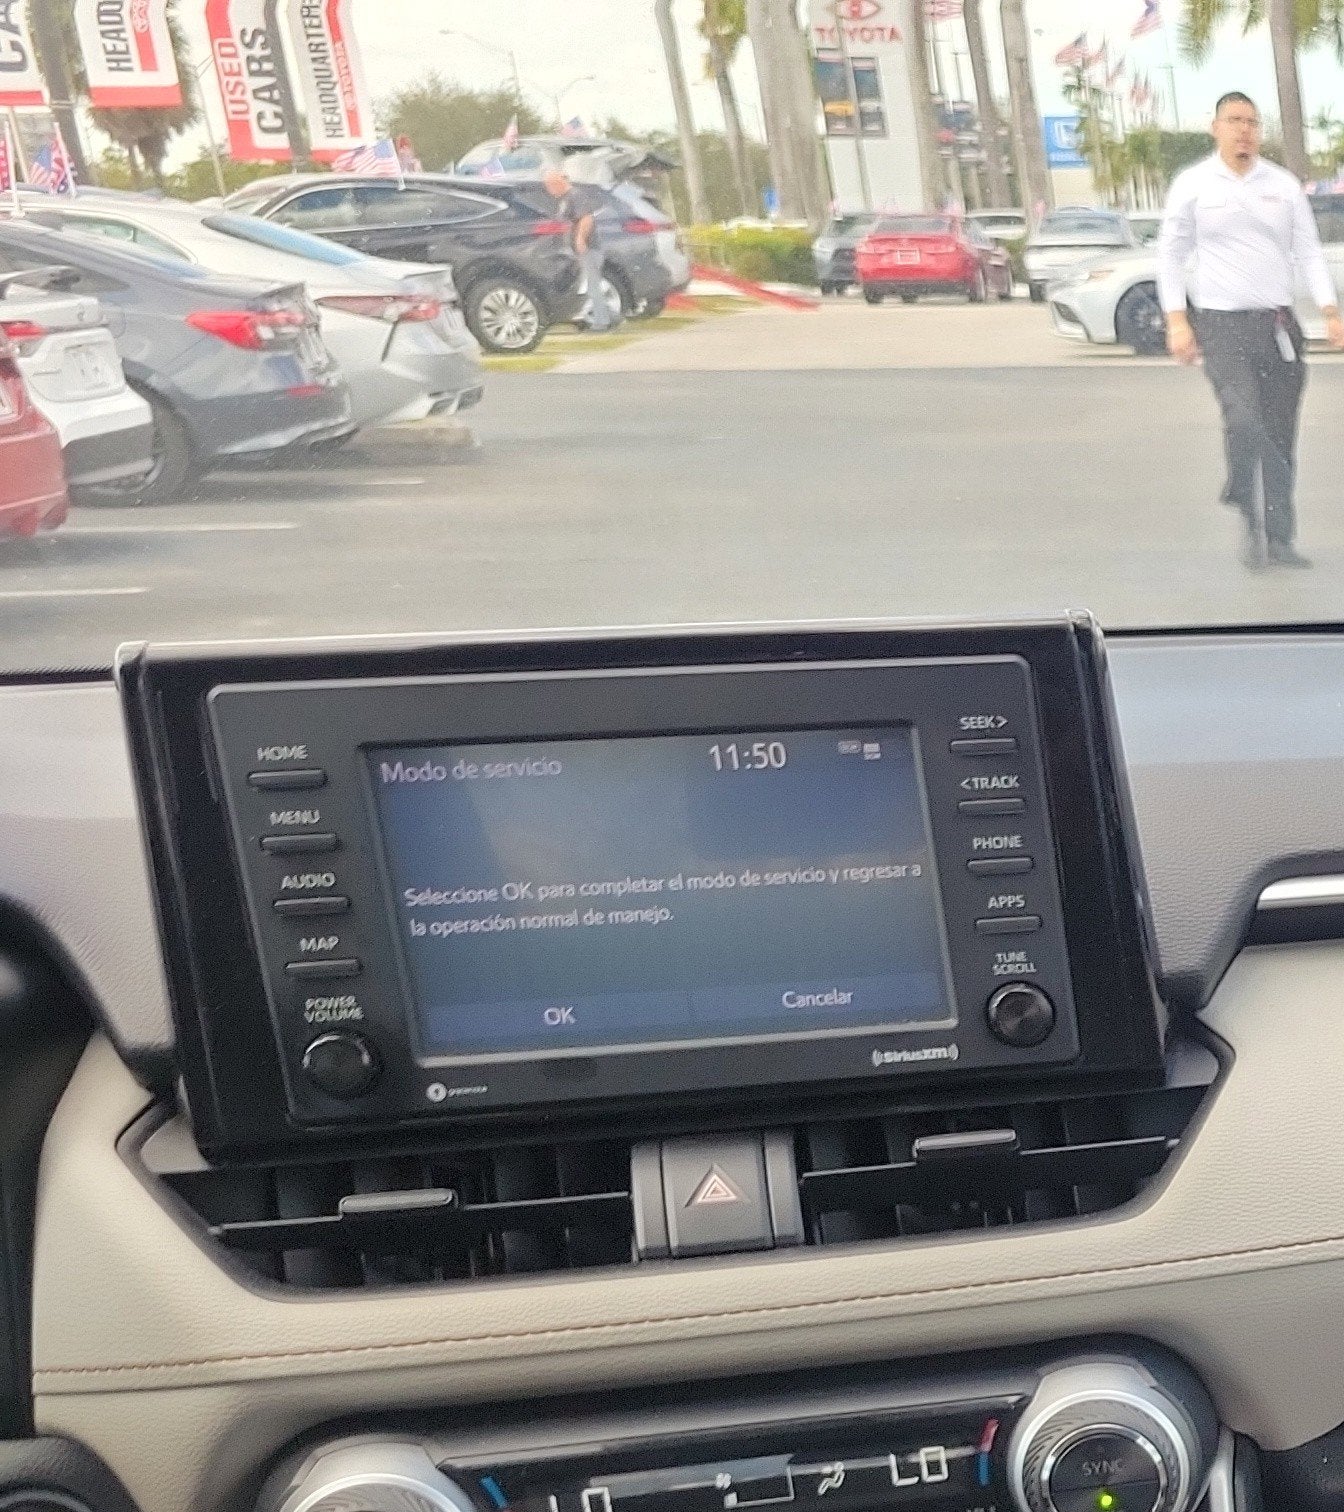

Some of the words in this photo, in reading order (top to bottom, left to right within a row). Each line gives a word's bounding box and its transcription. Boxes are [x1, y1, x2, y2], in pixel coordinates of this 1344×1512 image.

[218, 41, 249, 116] USED
[299, 0, 345, 138] HEADQUARTER
[240, 27, 285, 134] CARS
[256, 744, 309, 761] HOME
[709, 741, 787, 771] 11:50
[380, 760, 447, 783] Modo
[452, 758, 479, 779] de
[483, 756, 563, 779] servicio
[269, 808, 321, 826] MENU
[972, 835, 1023, 850] PHONE
[280, 871, 336, 890] AUDIO
[404, 886, 499, 906] Seleccione
[501, 881, 534, 901] OK
[537, 883, 576, 902] para
[579, 876, 666, 897] completar
[668, 872, 684, 891] el
[686, 870, 736, 890] modo
[739, 869, 761, 887] de
[763, 866, 826, 886] servicio
[828, 867, 841, 884] y
[843, 864, 909, 883] regresar
[911, 864, 922, 877] a
[987, 894, 1026, 909] APPS
[409, 918, 427, 937] la
[429, 913, 517, 938] operación
[519, 908, 580, 930] normal
[583, 907, 605, 926] de
[608, 905, 675, 925] manejo.
[299, 935, 340, 951] MAP
[995, 951, 1028, 963] TUNE
[304, 995, 357, 1011] POWER
[781, 988, 855, 1009] Cancelar
[303, 1007, 364, 1023] VOLUME
[543, 1005, 576, 1025] OK
[889, 1445, 949, 1487] LO
[1082, 1458, 1125, 1477] SYNC
